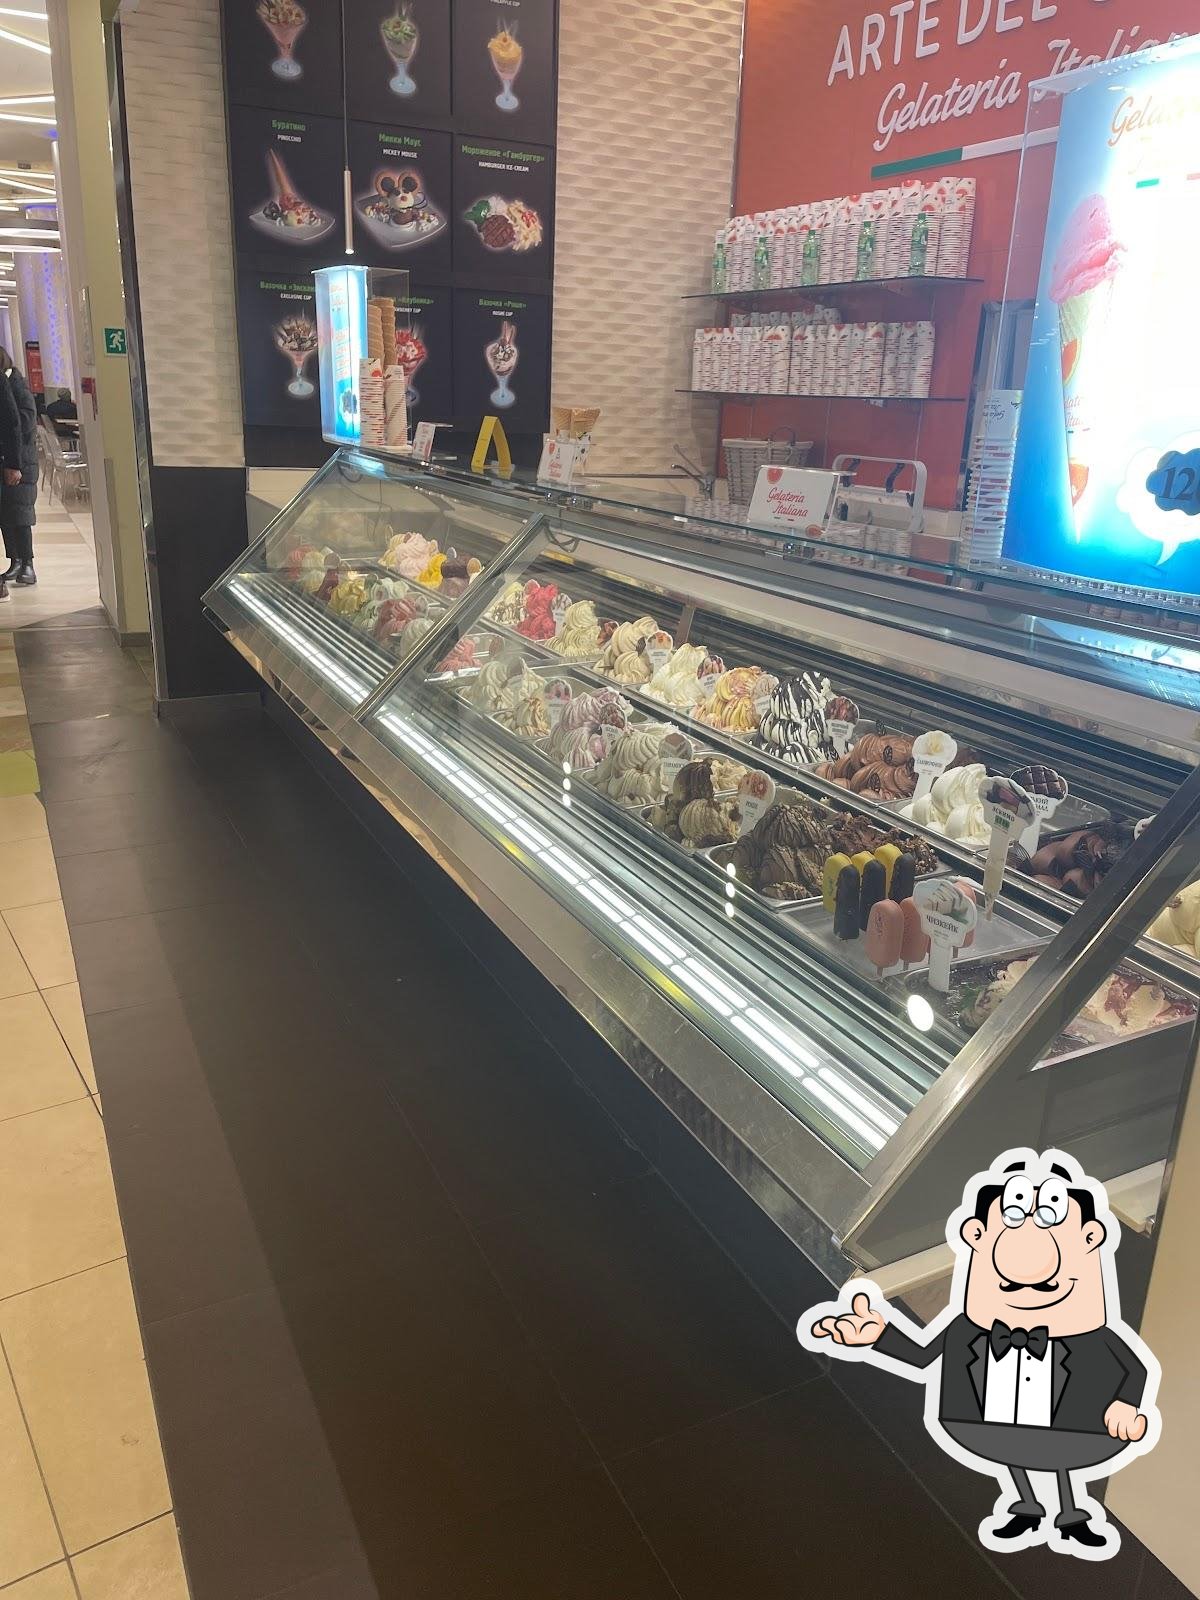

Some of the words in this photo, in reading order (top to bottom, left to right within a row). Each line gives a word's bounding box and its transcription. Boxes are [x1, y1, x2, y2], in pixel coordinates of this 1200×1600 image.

[827, 0, 940, 86] ARTE
[873, 59, 1022, 152] Gelateria
[272, 120, 306, 131] Буратино
[277, 134, 302, 143] PINOCCHIO
[378, 133, 402, 144] Микки
[403, 136, 422, 148] Маус
[382, 149, 401, 157] MICKEY
[401, 151, 418, 159] MOUSE
[461, 145, 501, 159] Мороженое
[478, 161, 505, 171] HAMBURGER
[1160, 466, 1200, 500] 12
[766, 486, 806, 503] Gelateria
[772, 502, 809, 518] Italiana
[992, 806, 1015, 822] ЭСКИМО
[926, 914, 960, 934] ЧИЗКЕЙК
